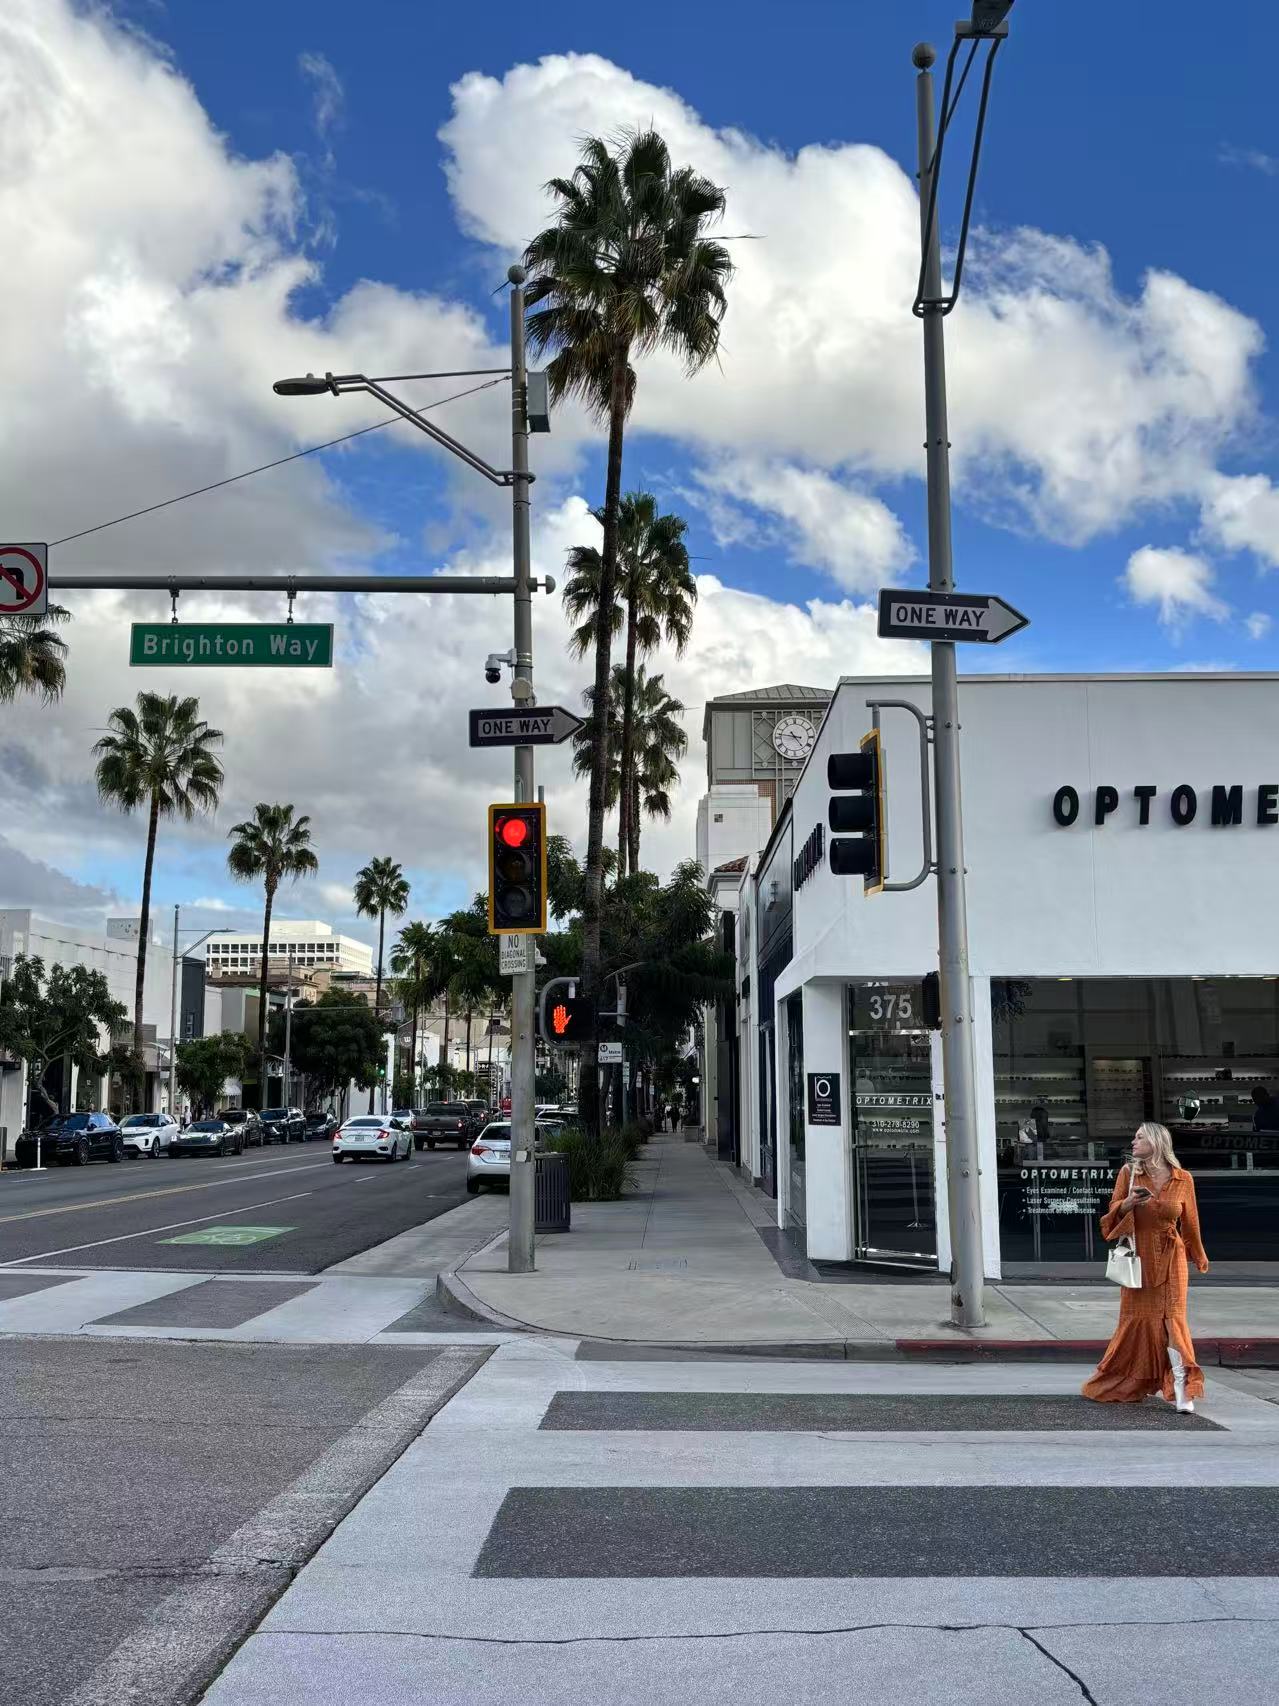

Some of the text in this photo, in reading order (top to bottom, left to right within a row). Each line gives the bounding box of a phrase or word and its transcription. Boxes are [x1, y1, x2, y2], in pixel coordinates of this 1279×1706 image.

[896, 605, 985, 627] ONE WAY
[143, 634, 319, 662] Brighton Way
[482, 719, 551, 735] ONE WAY
[1052, 784, 1279, 827] OPTOME
[508, 934, 519, 948] NO
[501, 949, 526, 960] DIAGONAL
[501, 959, 526, 970] CROSSING
[869, 994, 912, 1019] 375
[856, 1096, 932, 1105] OPTOMETRIX
[1020, 1169, 1114, 1179] OPTOMETRIX
[1026, 1186, 1039, 1195] Eyes
[1040, 1186, 1067, 1194] Examined
[1043, 1197, 1065, 1205] Surgery
